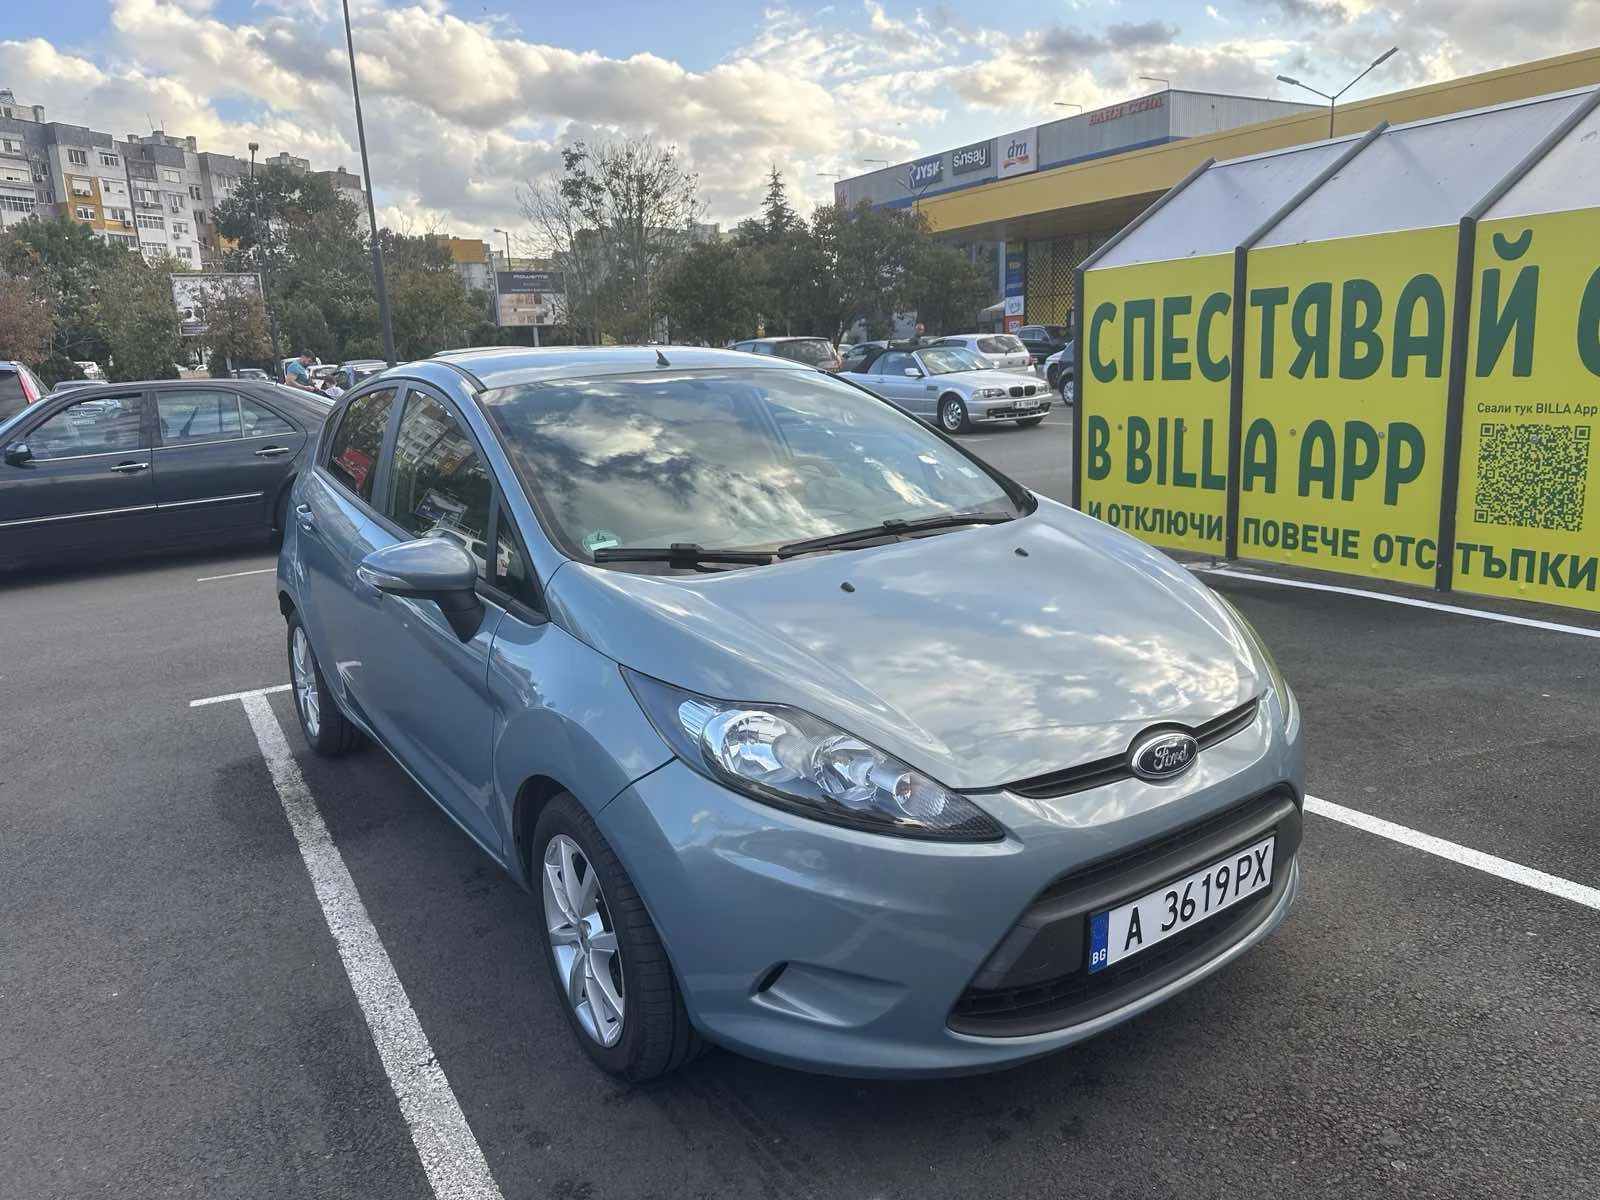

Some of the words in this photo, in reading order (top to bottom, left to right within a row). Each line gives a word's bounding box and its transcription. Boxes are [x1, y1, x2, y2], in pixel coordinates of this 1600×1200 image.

[953, 147, 986, 168] sinsay
[1008, 139, 1028, 158] dm
[915, 161, 940, 180] JYSK
[1088, 229, 1540, 384] СПЕСТЯВАЙ
[1477, 403, 1511, 413] Свали
[1514, 404, 1533, 416] тук
[1536, 403, 1571, 414] BILLA
[1574, 403, 1598, 416] App
[1126, 415, 1278, 494] BILLA
[1298, 419, 1426, 506] APP
[1088, 501, 1102, 520] И
[1107, 503, 1223, 541] ОТКЛЮЧИ
[1243, 518, 1360, 559] ПОВЕЧЕ
[1373, 533, 1599, 591] ОТСТЪПКИ
[1153, 742, 1189, 771] Ford
[1124, 906, 1143, 951] A
[1161, 844, 1269, 932] 3619PX
[1092, 948, 1106, 965] BG
